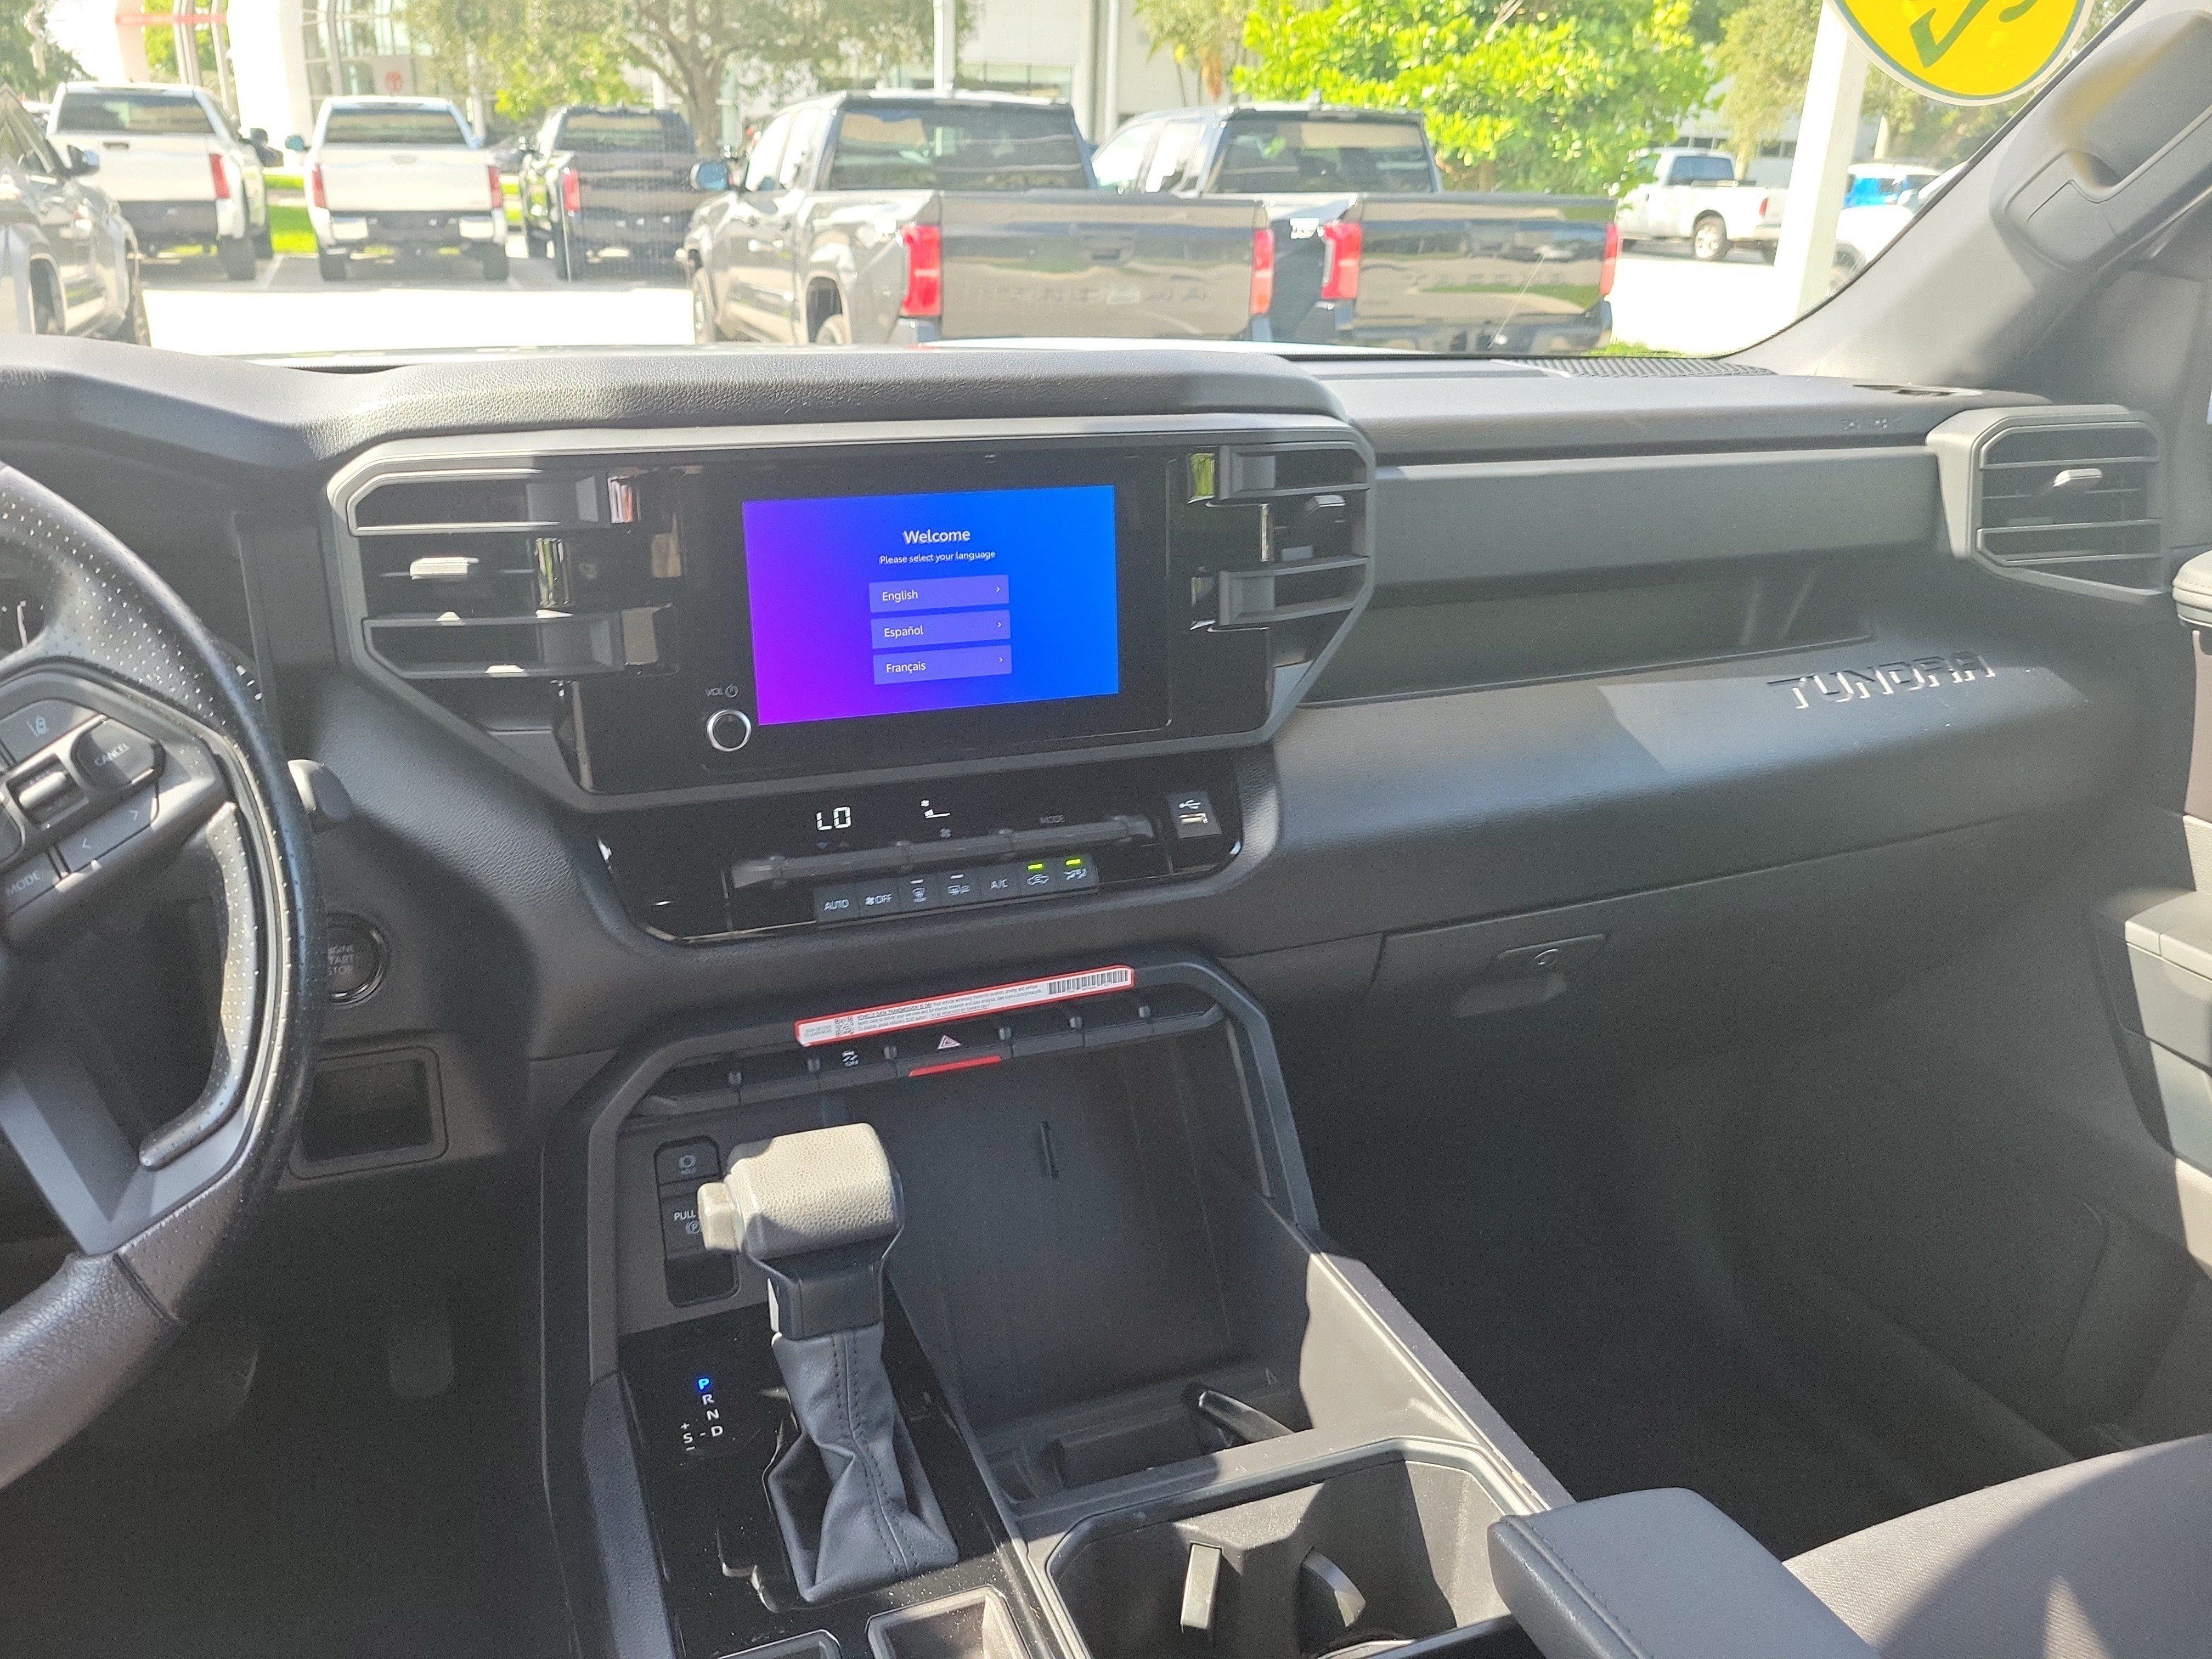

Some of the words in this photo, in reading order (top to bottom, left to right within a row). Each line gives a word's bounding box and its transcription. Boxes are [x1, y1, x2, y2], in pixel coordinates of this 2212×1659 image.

[903, 528, 971, 544] Welcome
[879, 555, 907, 565] Please
[909, 553, 934, 563] select
[935, 552, 954, 564] your
[955, 550, 996, 562] language
[882, 589, 918, 603] English
[884, 624, 924, 639] Español
[886, 661, 927, 674] Français
[1767, 651, 1996, 709] TUNDRA
[94, 742, 131, 766] CANCEL
[6, 871, 40, 895] MODE
[990, 878, 1009, 890] A/C
[823, 899, 849, 911] AUTO
[674, 1209, 696, 1221] PULL
[698, 1378, 709, 1390] P
[702, 1393, 715, 1406] R
[706, 1408, 719, 1420] N
[711, 1425, 723, 1437] D
[683, 1432, 693, 1444] S
